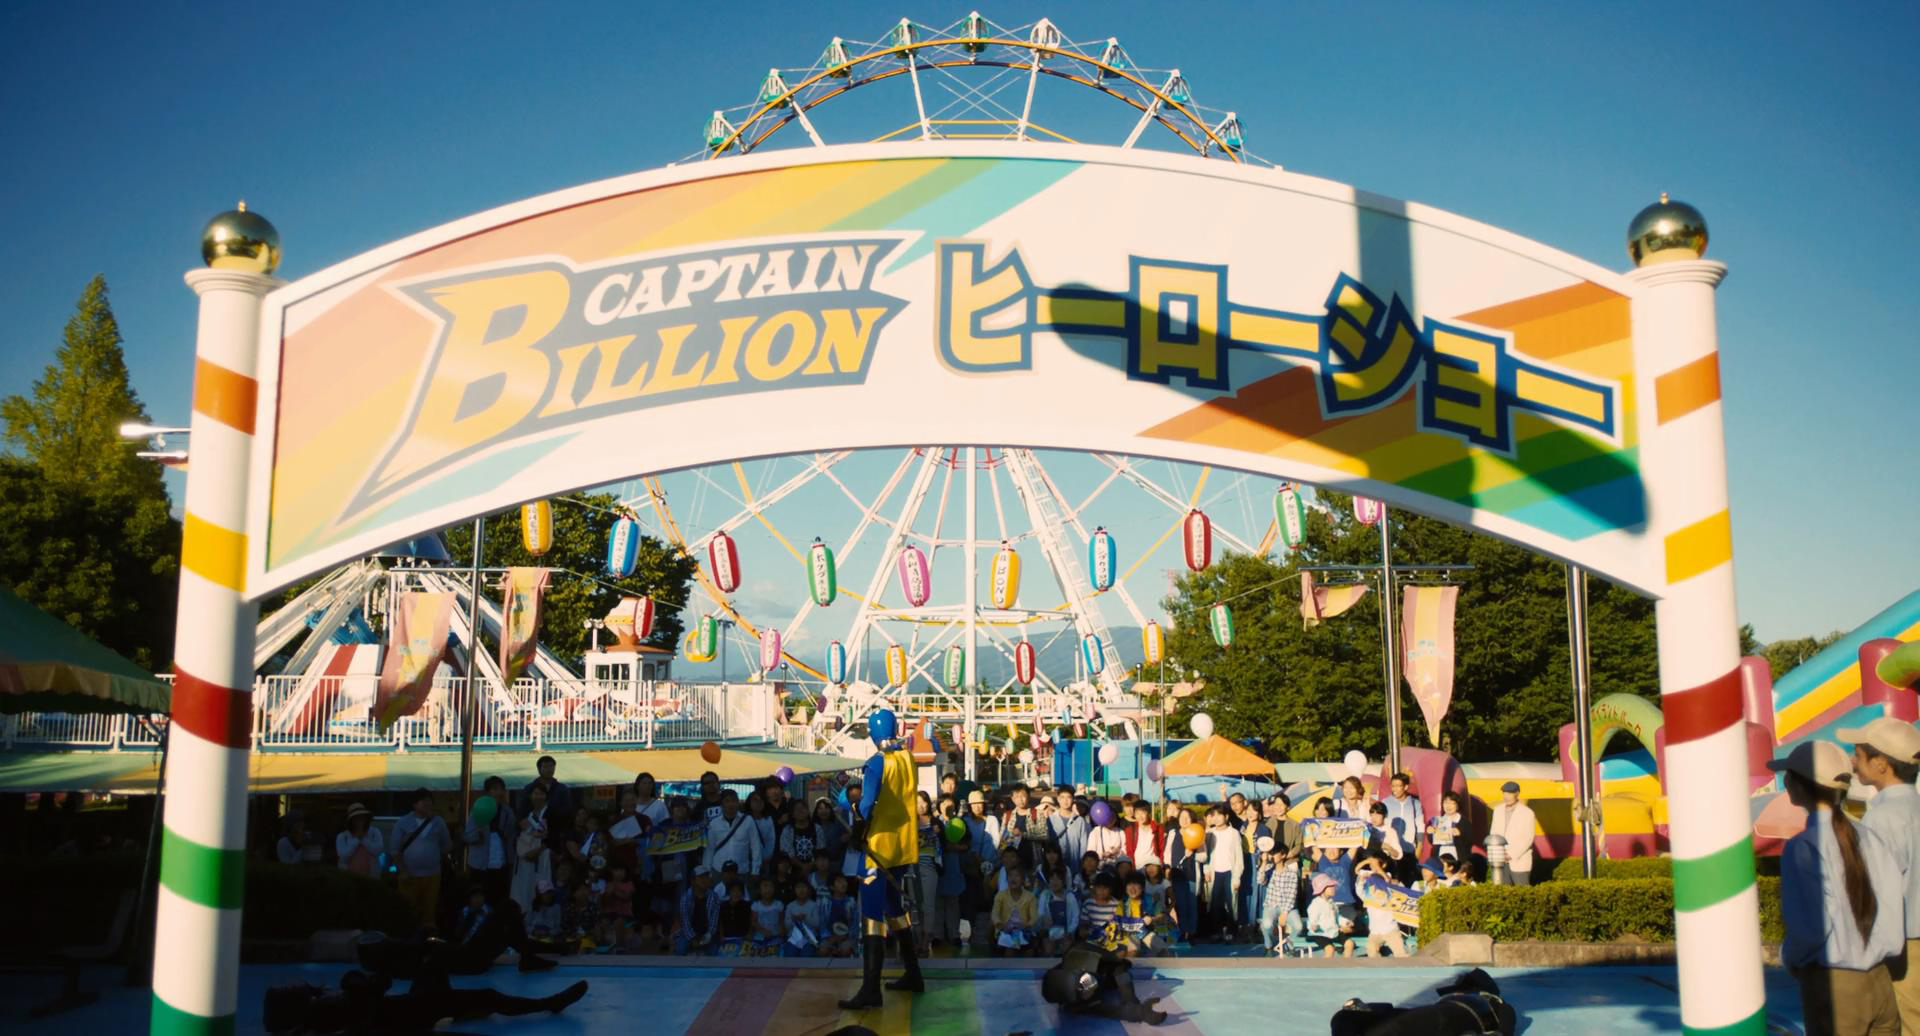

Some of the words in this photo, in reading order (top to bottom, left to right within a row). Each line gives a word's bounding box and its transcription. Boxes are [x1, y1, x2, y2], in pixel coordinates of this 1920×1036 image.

[376, 269, 889, 484] BILLION
[583, 244, 880, 326] CAPTAIN
[938, 242, 1614, 452] ヒーローショー
